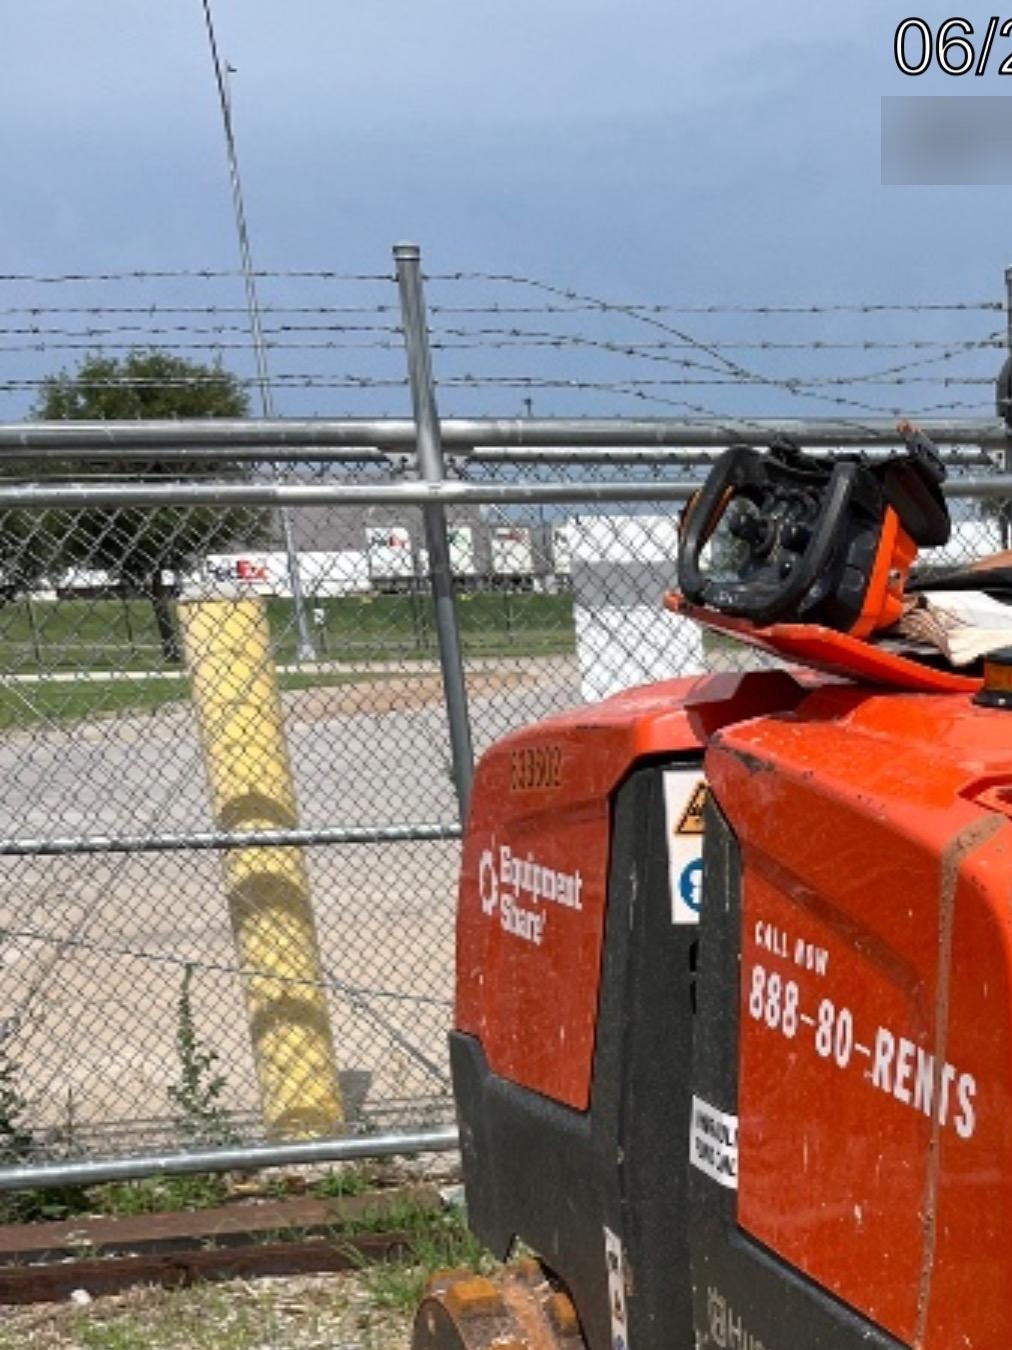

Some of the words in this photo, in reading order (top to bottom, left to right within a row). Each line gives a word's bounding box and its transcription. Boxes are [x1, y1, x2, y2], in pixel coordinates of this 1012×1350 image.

[207, 560, 268, 581] FedEx
[499, 846, 583, 912] Equipment
[500, 893, 542, 946] Share
[755, 920, 788, 958] CALL
[794, 938, 830, 976] NOW
[750, 965, 977, 1139] 888-80-RENTS
